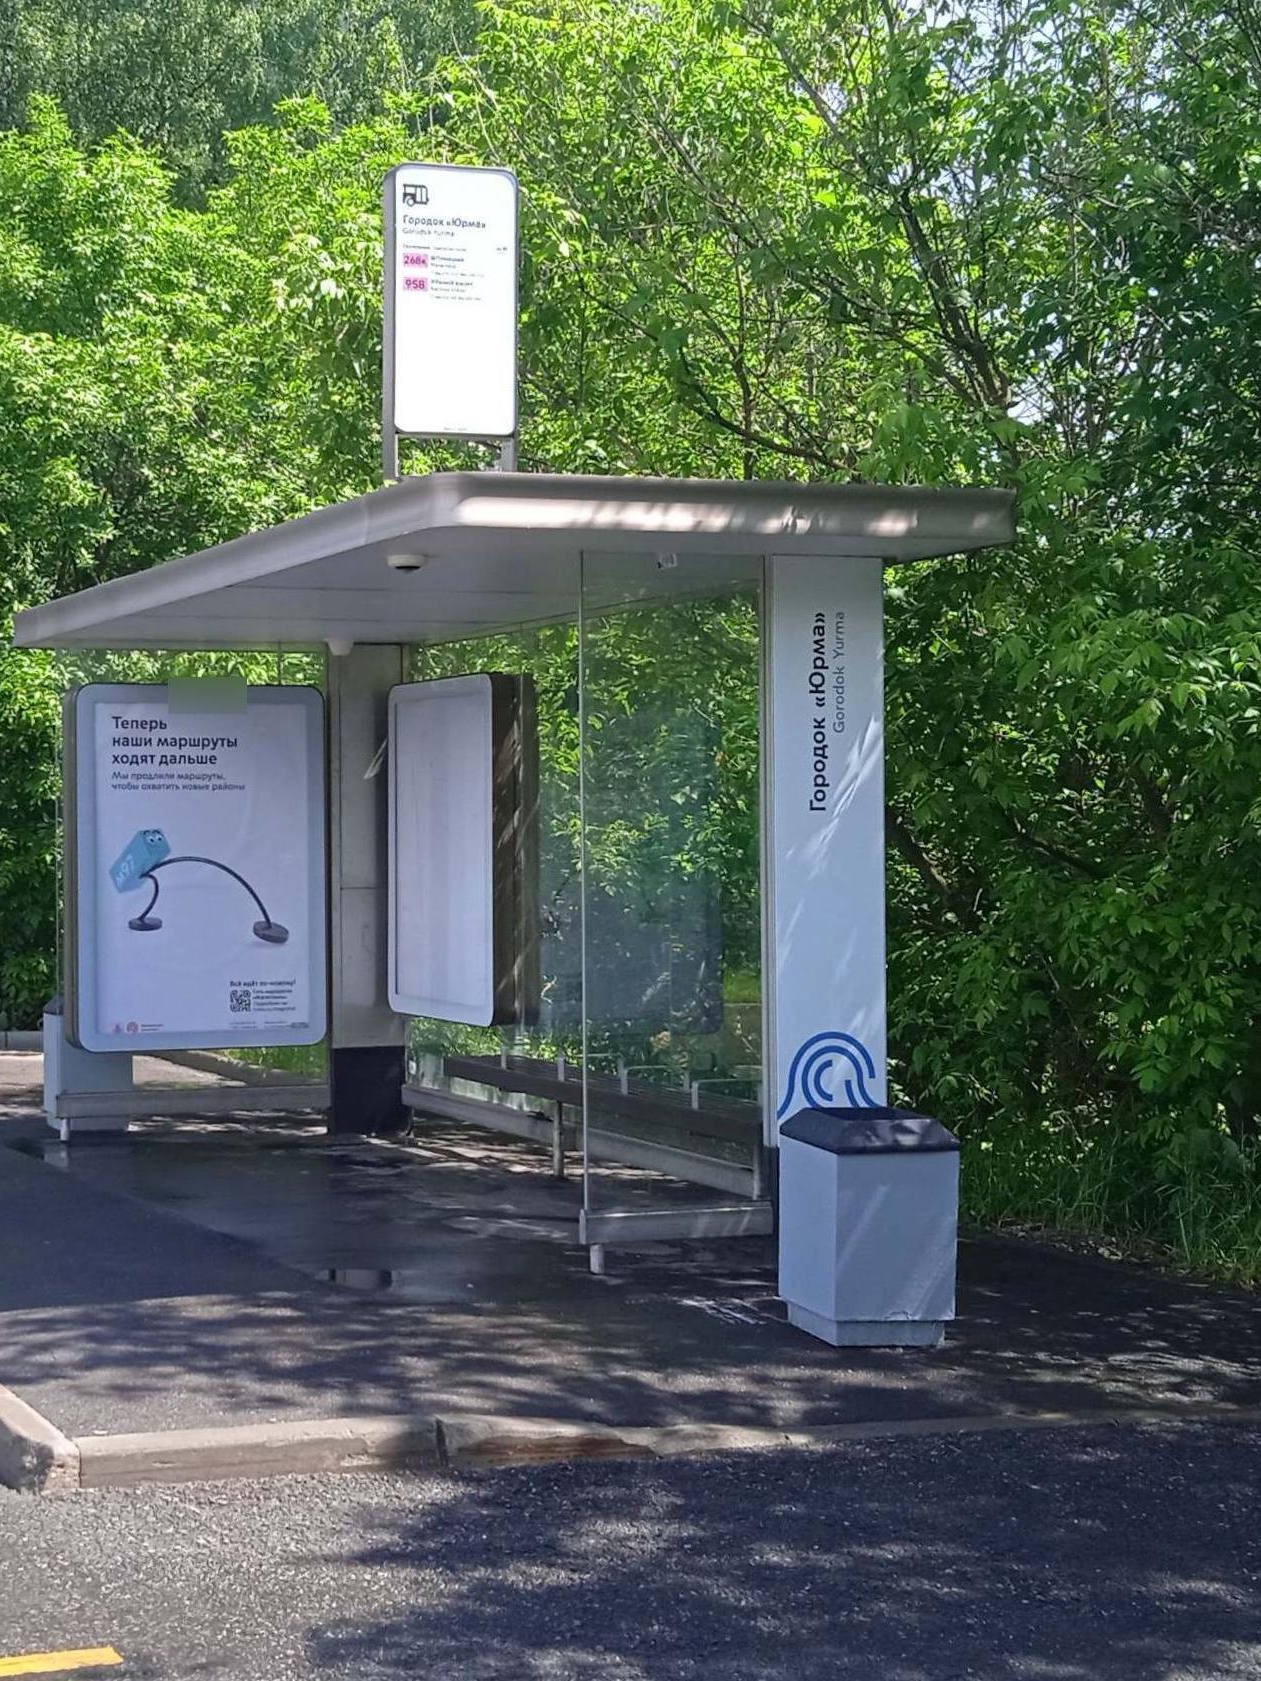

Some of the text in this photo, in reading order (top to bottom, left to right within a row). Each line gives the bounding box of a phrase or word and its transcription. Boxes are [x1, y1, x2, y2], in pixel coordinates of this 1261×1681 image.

[402, 214, 444, 226] Городок
[405, 279, 425, 290] 958
[832, 611, 845, 733] Gorodok Yurma
[809, 612, 830, 811] Городок «Юрма»
[111, 715, 168, 733] Теперь
[112, 736, 238, 750] наши маршруты
[112, 754, 218, 767] ходят дальше
[112, 771, 129, 780] Мы
[131, 772, 175, 782] продлили
[111, 782, 246, 792] чтобы охватить новые районы
